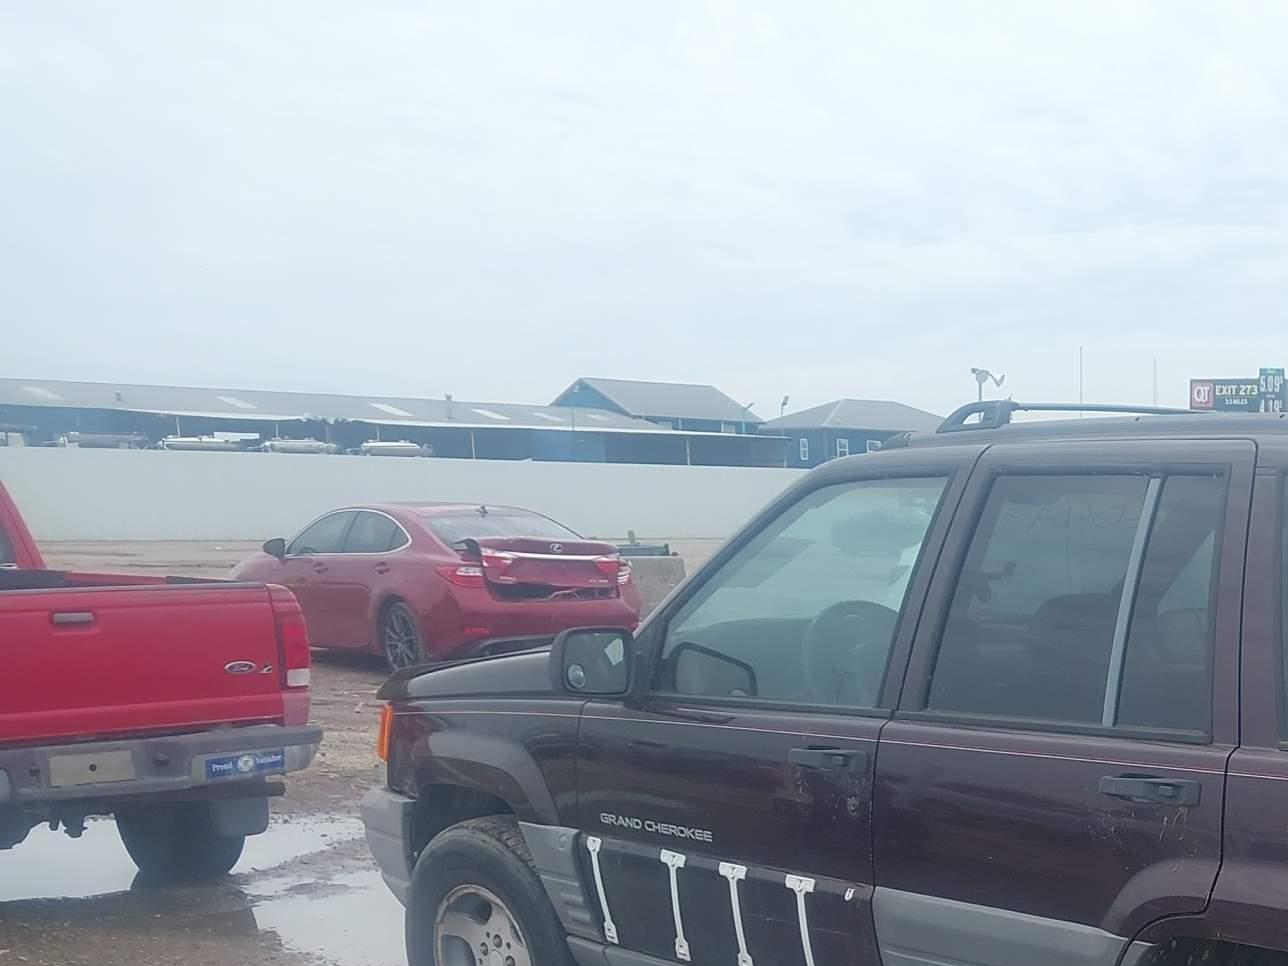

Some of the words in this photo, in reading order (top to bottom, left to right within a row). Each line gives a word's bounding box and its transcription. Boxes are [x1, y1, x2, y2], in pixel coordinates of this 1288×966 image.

[1194, 386, 1210, 404] QT
[1216, 385, 1237, 396] EXIT
[1239, 385, 1258, 395] 273
[600, 812, 642, 829] GRAND
[645, 820, 713, 842] CHEROKEE
